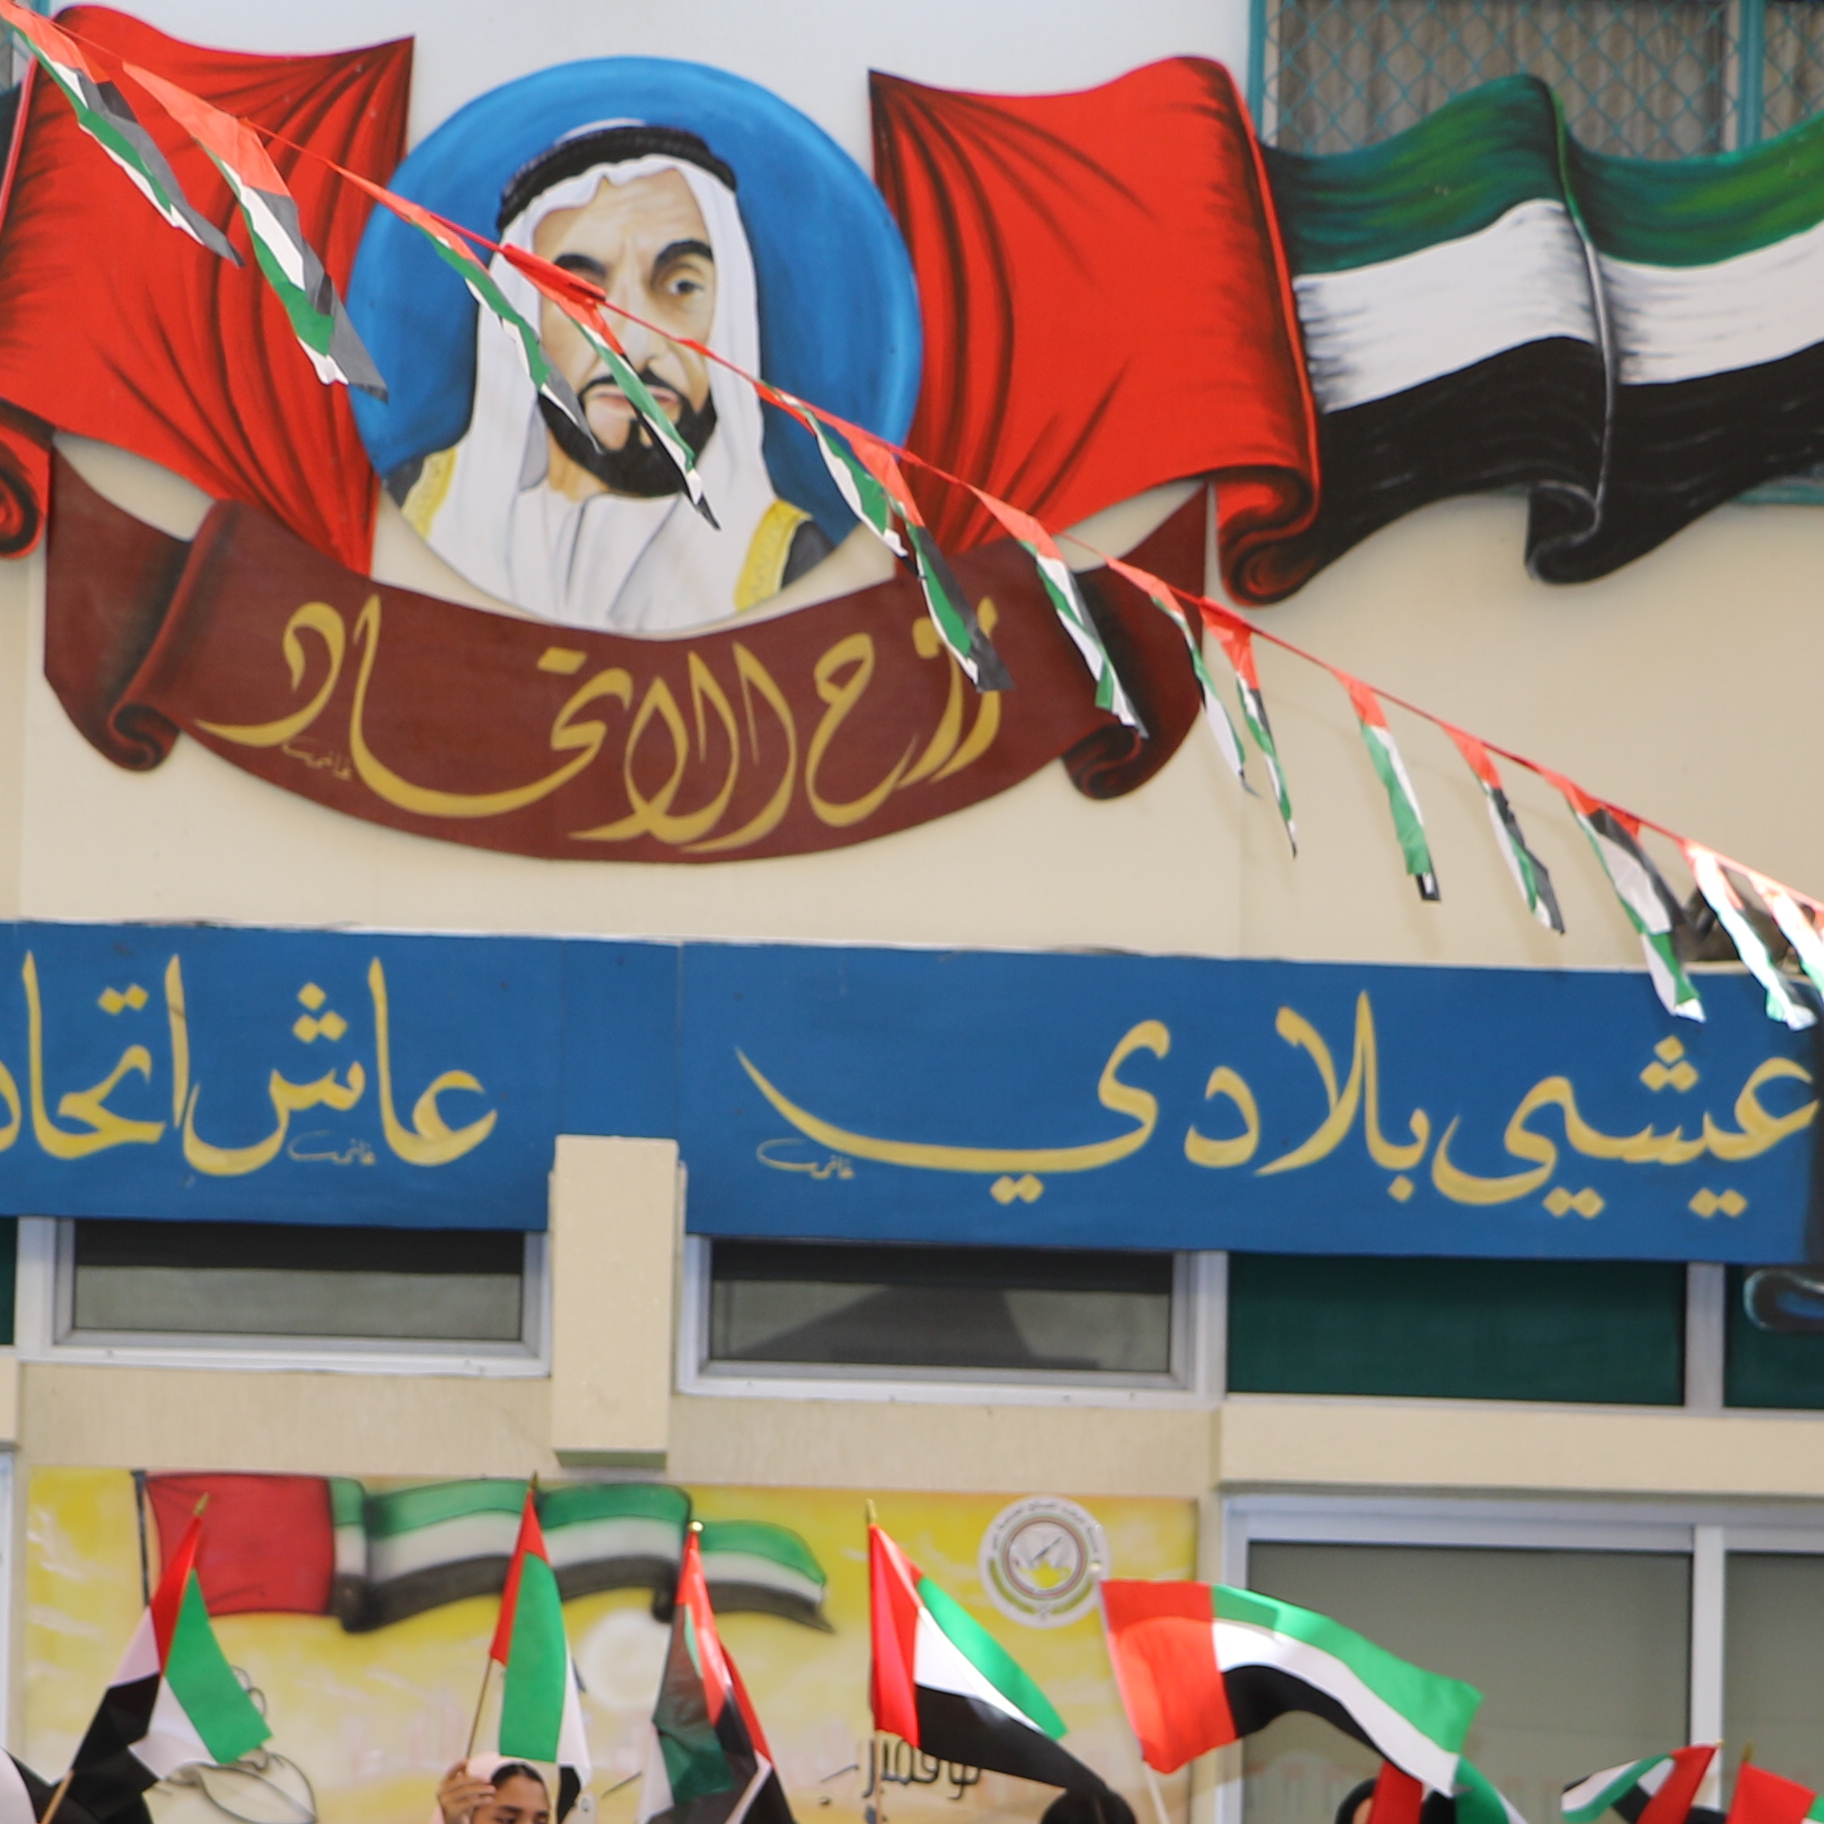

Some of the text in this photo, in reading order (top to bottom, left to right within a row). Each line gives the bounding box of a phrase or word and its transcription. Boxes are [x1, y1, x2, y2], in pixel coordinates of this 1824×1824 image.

[194, 593, 798, 854] الاتحاد
[181, 957, 499, 1178] عاش
[733, 989, 1432, 1205] بلادي
